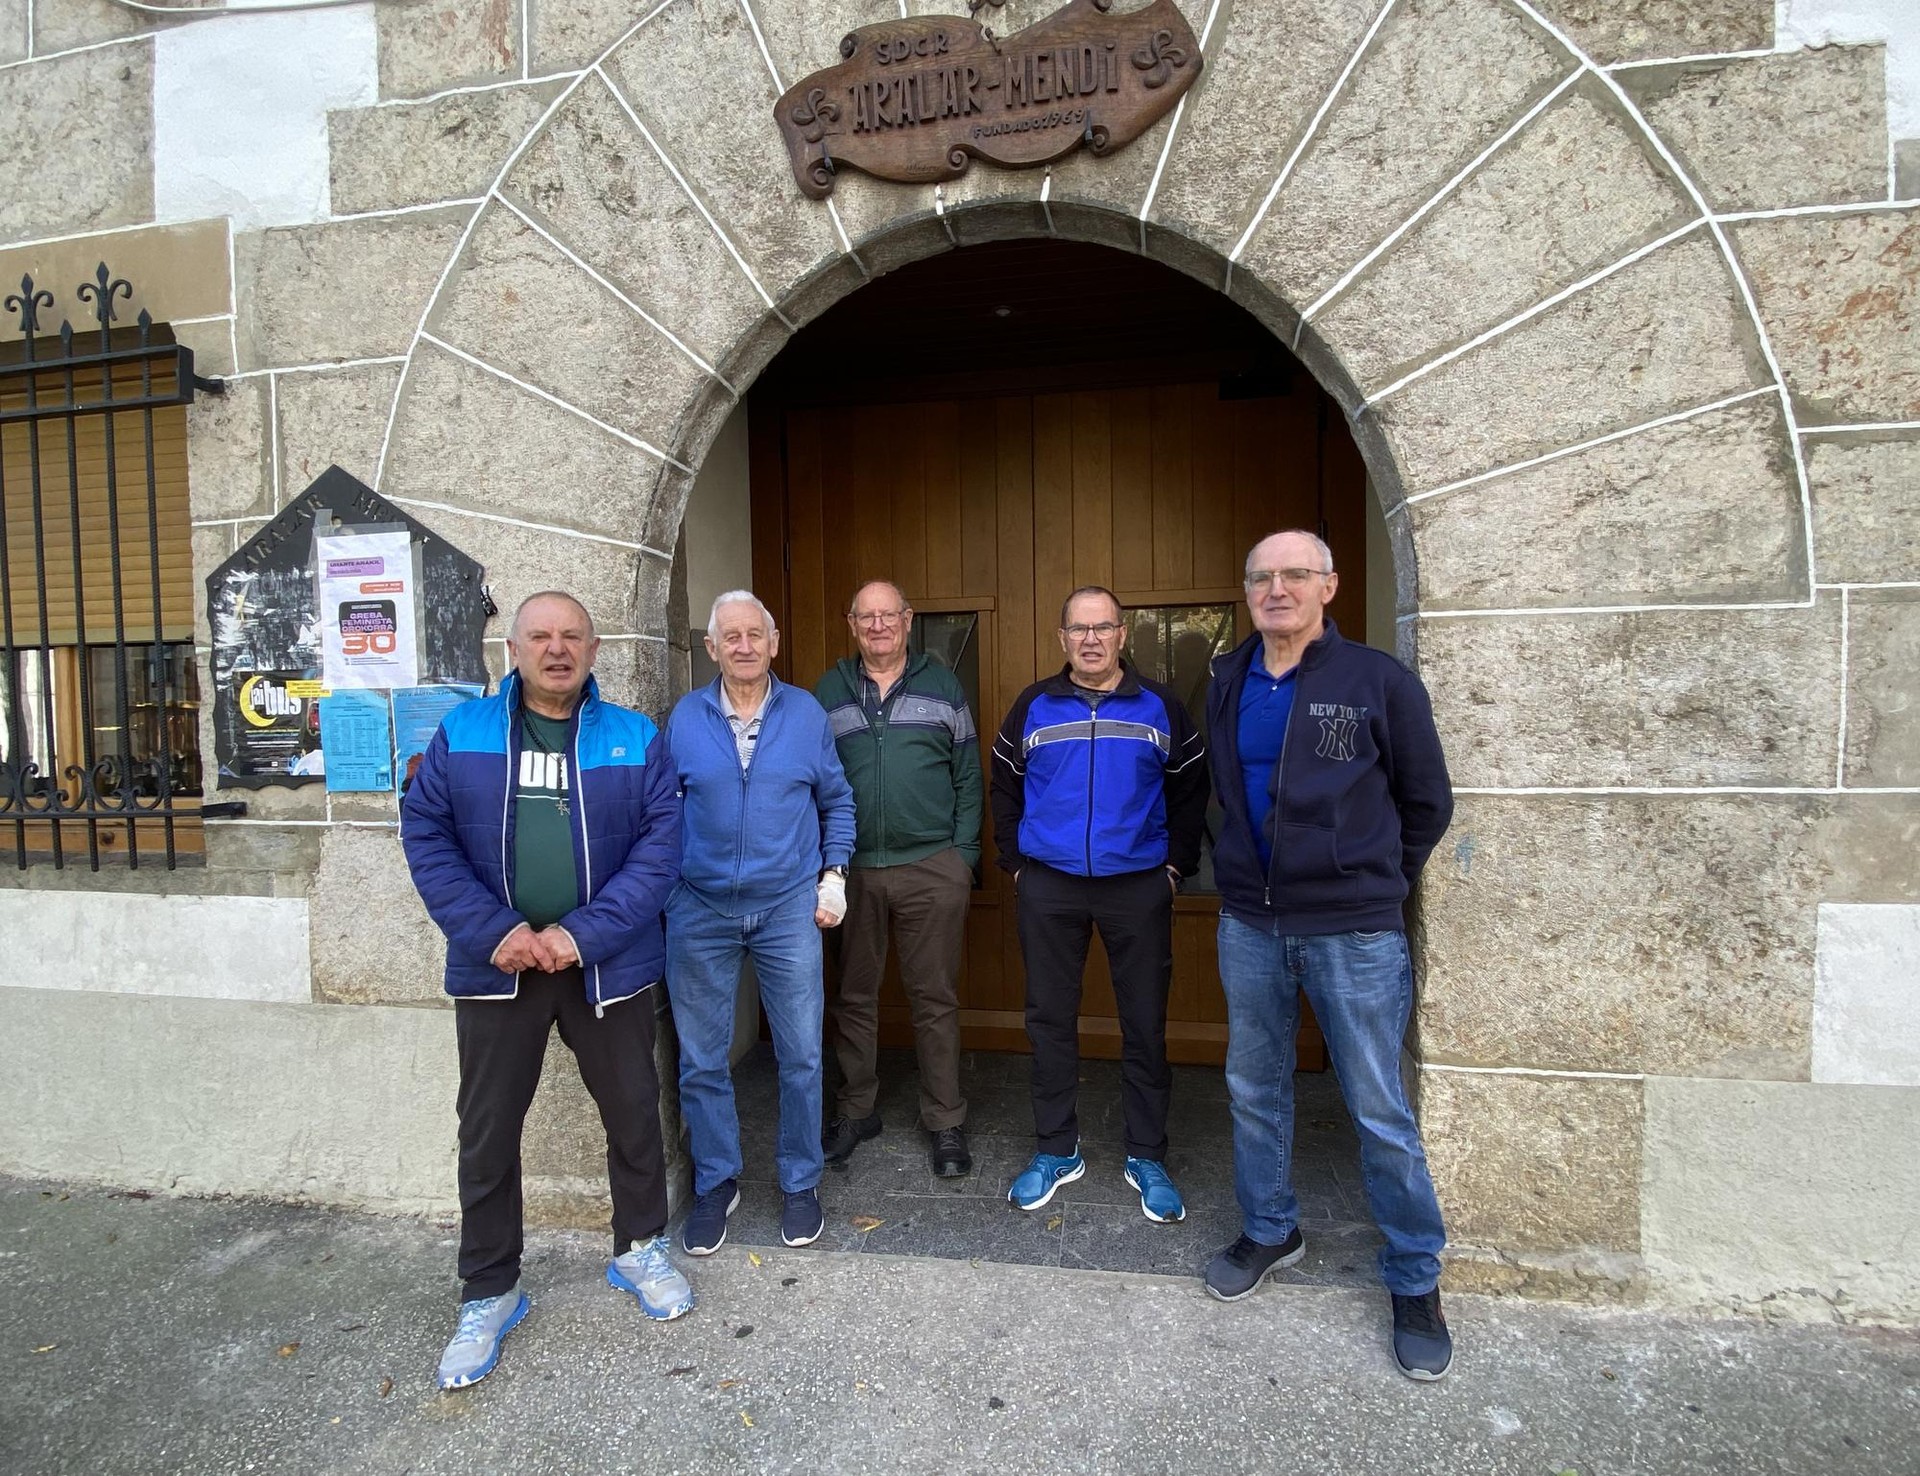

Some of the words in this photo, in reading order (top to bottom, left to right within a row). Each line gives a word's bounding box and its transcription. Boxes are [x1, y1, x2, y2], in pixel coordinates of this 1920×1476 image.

[875, 31, 949, 65] SDCR
[341, 617, 393, 626] FEMINISTA
[350, 612, 383, 620] GREBA
[342, 634, 396, 655] 30
[1309, 703, 1337, 717] NEW
[1339, 705, 1368, 720] YORK
